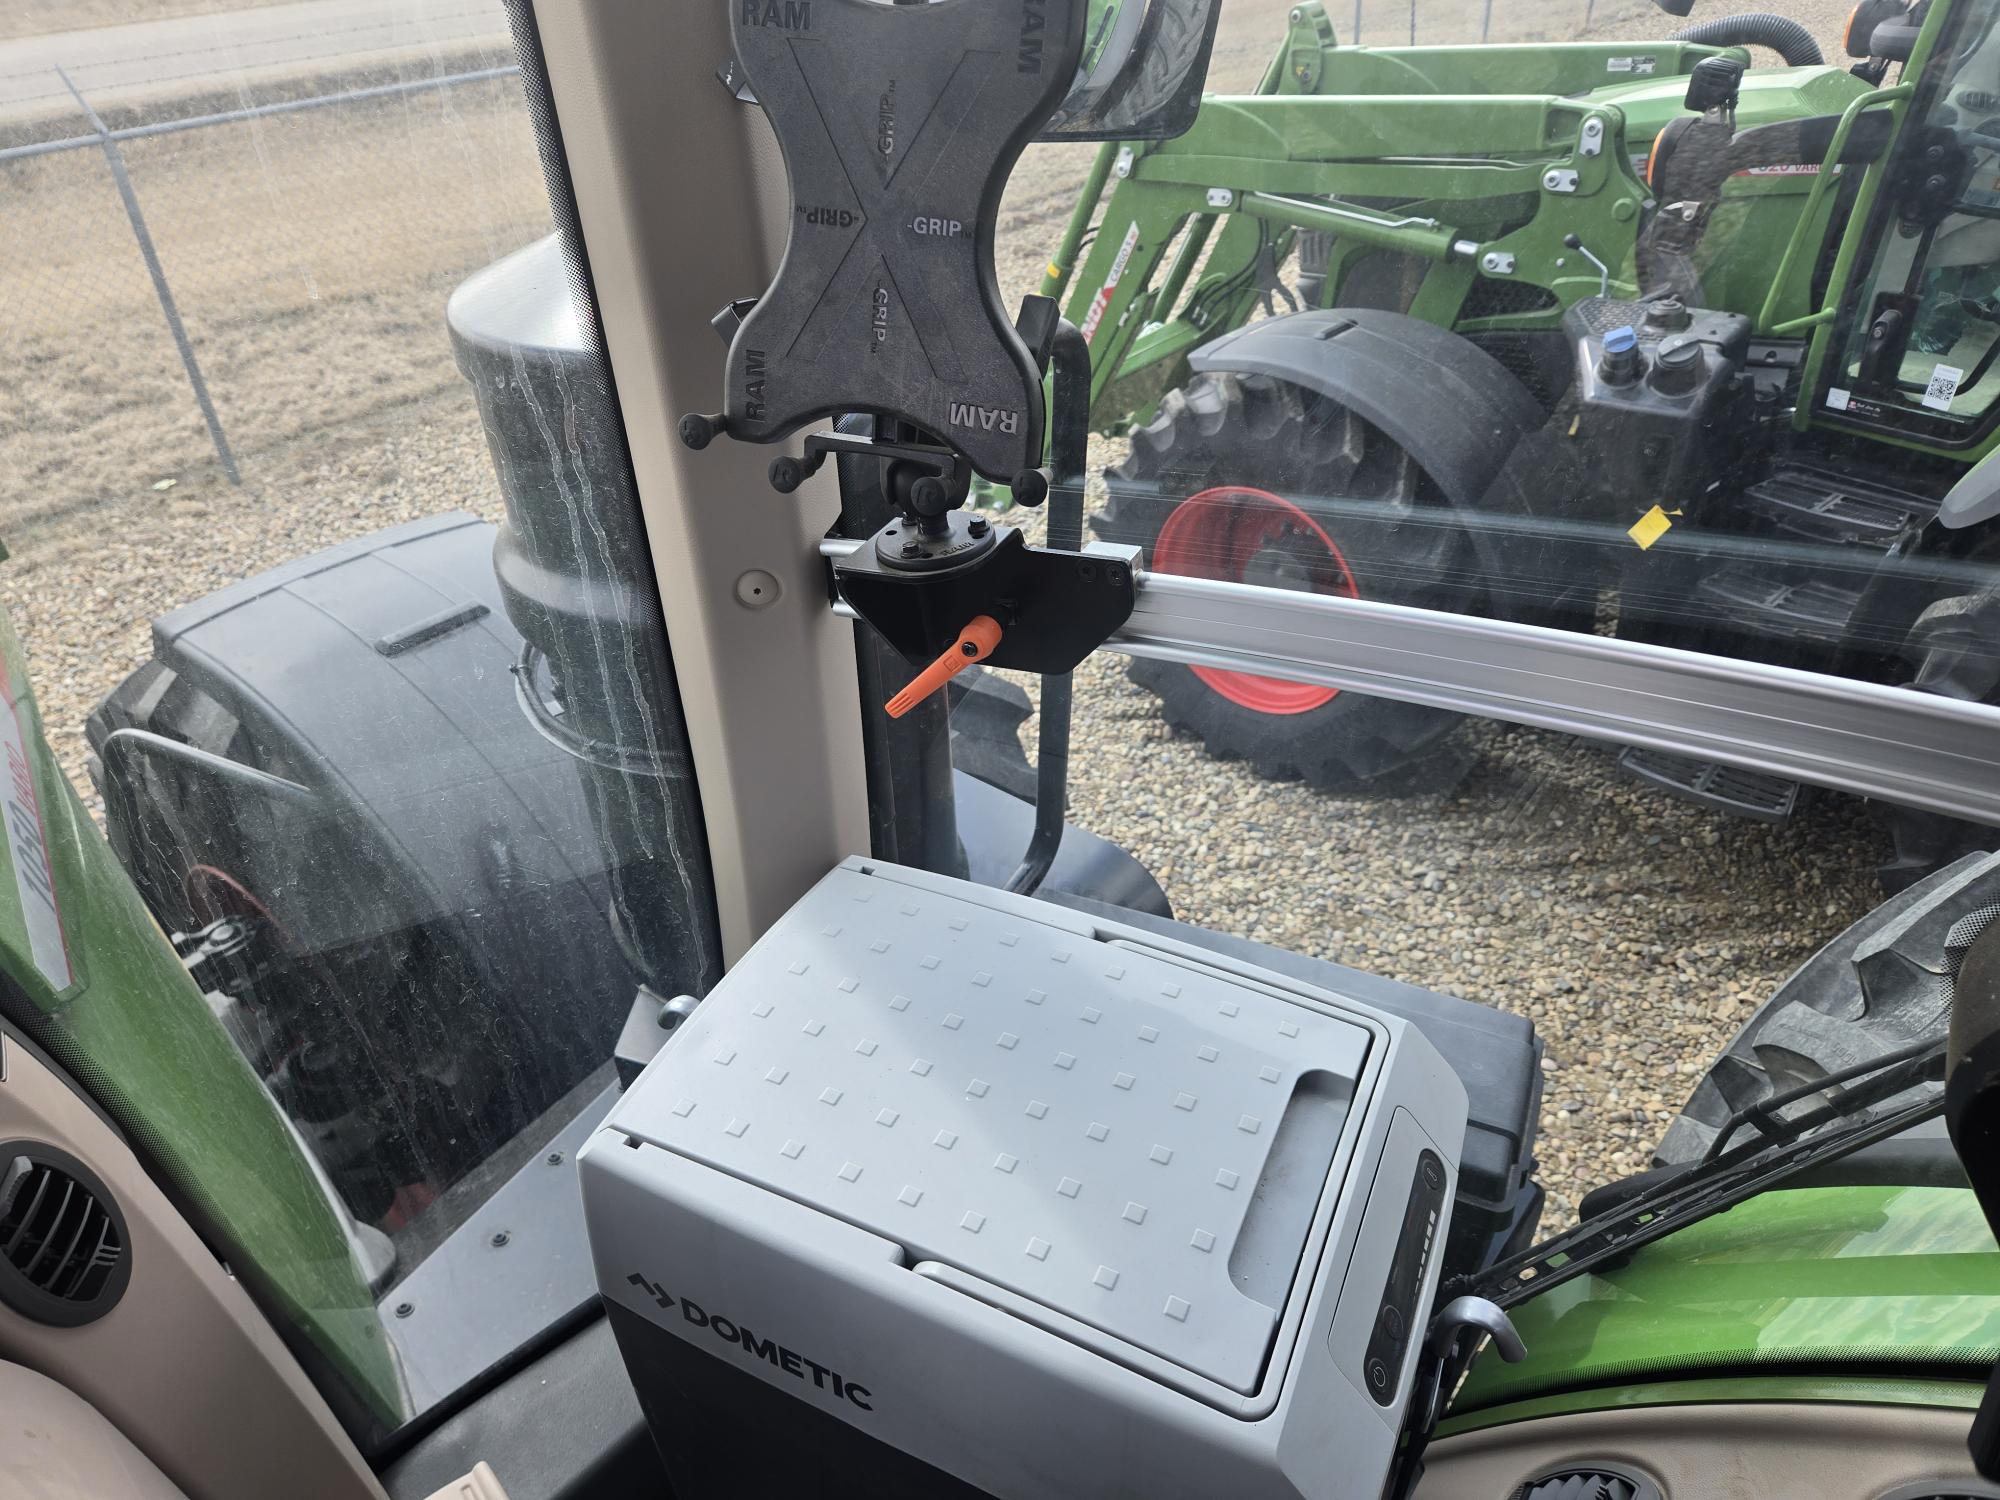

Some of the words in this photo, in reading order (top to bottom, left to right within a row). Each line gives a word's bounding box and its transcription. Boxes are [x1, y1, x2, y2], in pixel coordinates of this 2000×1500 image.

[742, 0, 811, 30] RAM
[1017, 0, 1046, 75] AM
[745, 350, 766, 423] RAM
[950, 402, 1018, 435] RAM
[680, 1296, 874, 1412] DOMETIC
